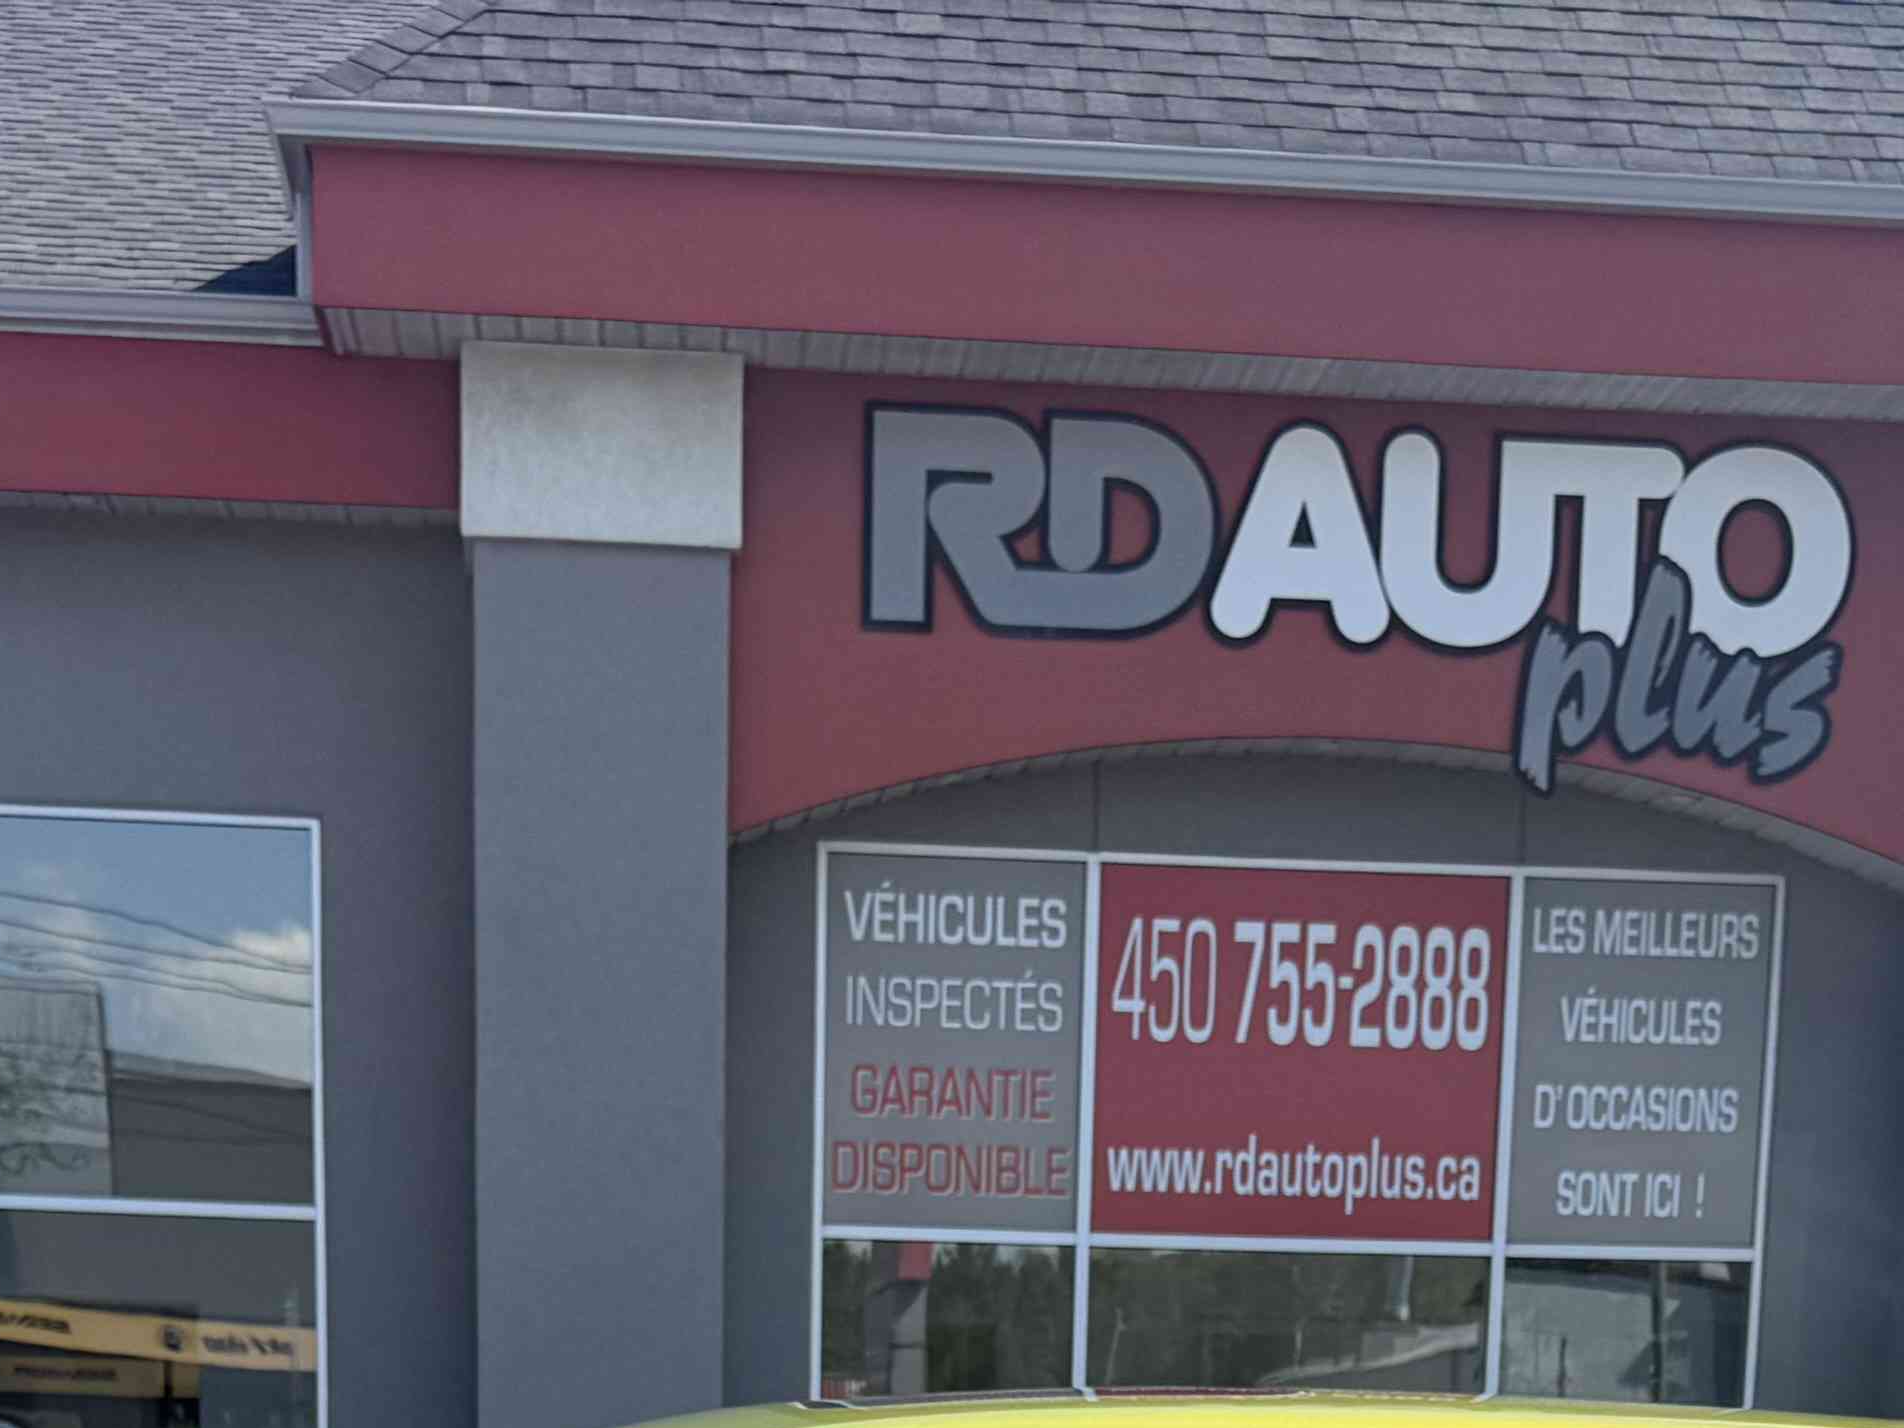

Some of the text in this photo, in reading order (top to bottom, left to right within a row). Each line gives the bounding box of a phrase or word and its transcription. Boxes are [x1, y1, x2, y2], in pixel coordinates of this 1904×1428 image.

[1516, 556, 1842, 792] plus
[844, 880, 1068, 949] VÉHICULES
[1532, 907, 1761, 960] LES MEILLEURS
[845, 969, 1064, 1033] INSPECTÉS
[1111, 916, 1492, 1052] 450 755-2888
[1560, 985, 1723, 1046] VÉHICULES
[850, 1063, 1057, 1123] GARANTIE
[830, 1140, 1073, 1199] DISPONIBLE
[1106, 1133, 1482, 1216] www.rdautoplus.ca
[1555, 1169, 1640, 1217] SONT
[1645, 1172, 1681, 1219] ICI
